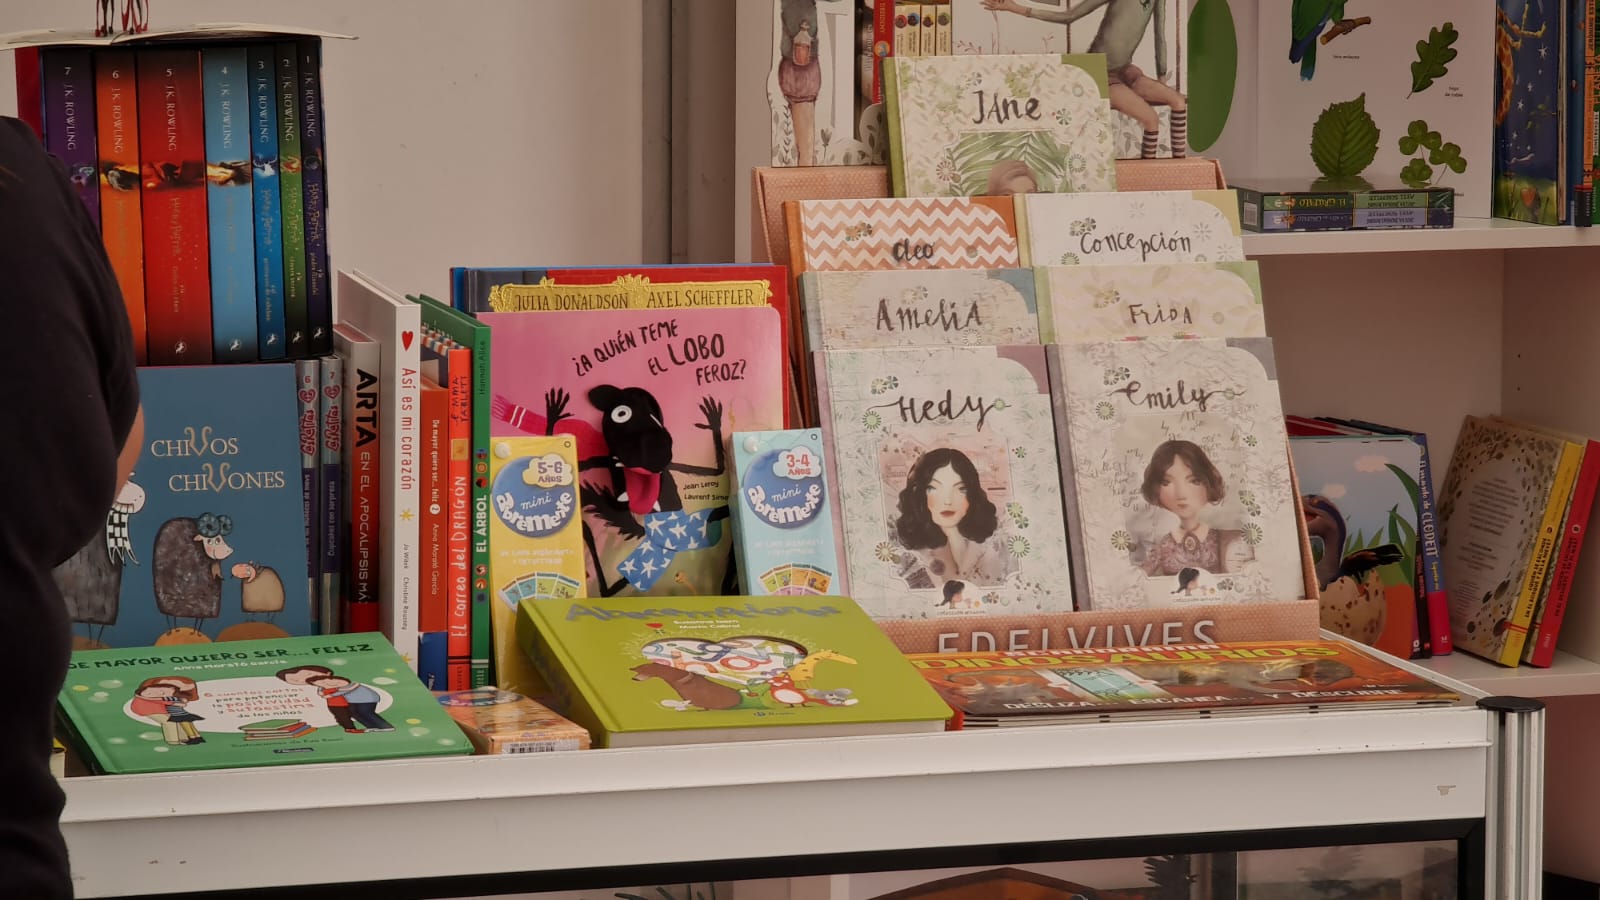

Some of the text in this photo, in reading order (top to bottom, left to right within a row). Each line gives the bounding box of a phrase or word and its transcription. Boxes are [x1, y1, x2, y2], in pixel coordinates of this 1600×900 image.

[65, 67, 72, 76] 7
[165, 68, 173, 78] 5
[221, 66, 229, 76] 4
[257, 61, 265, 70] 3
[306, 56, 311, 64] 1
[112, 70, 119, 79] 6
[64, 101, 76, 152] ROWLING
[166, 103, 177, 152] ROWLING
[221, 101, 232, 149] ROWLING
[258, 95, 269, 143] ROWLING
[284, 93, 294, 142] ROWLING
[305, 89, 317, 138] ROWLING
[112, 105, 124, 154] ROWLING
[1079, 230, 1192, 262] Concepción
[514, 288, 754, 311] JULIA DONALDSON AXEL SCHEFFLER
[638, 318, 679, 345] TEME
[647, 333, 725, 376] EL LOBO
[696, 358, 747, 387] FEROZ?
[868, 389, 1010, 431] Hedy
[1112, 379, 1237, 413] Emily
[150, 426, 240, 457] CHIVOS
[400, 367, 417, 491] Así es mi corazón
[431, 428, 440, 449] mayor
[430, 450, 440, 472] quiero
[537, 461, 563, 475] 5-6
[786, 453, 810, 468] 3-4
[168, 462, 286, 493] CHIVONES
[356, 367, 378, 603] ARTA EN EL APOCALIPSIS MÁ
[683, 481, 720, 490] Jean Leroy
[520, 491, 552, 510] mini
[684, 493, 711, 501] Laurent
[771, 484, 802, 504] mini
[449, 476, 468, 542] DRAGÓN
[473, 495, 488, 553] EL ÁRBOL
[453, 576, 468, 617] Correo
[450, 624, 468, 637] EL
[94, 655, 164, 669] MAYOR
[169, 651, 248, 666] QUIERO
[313, 643, 374, 656] FELIZ
[915, 645, 1339, 669] DINOSAURIOS
